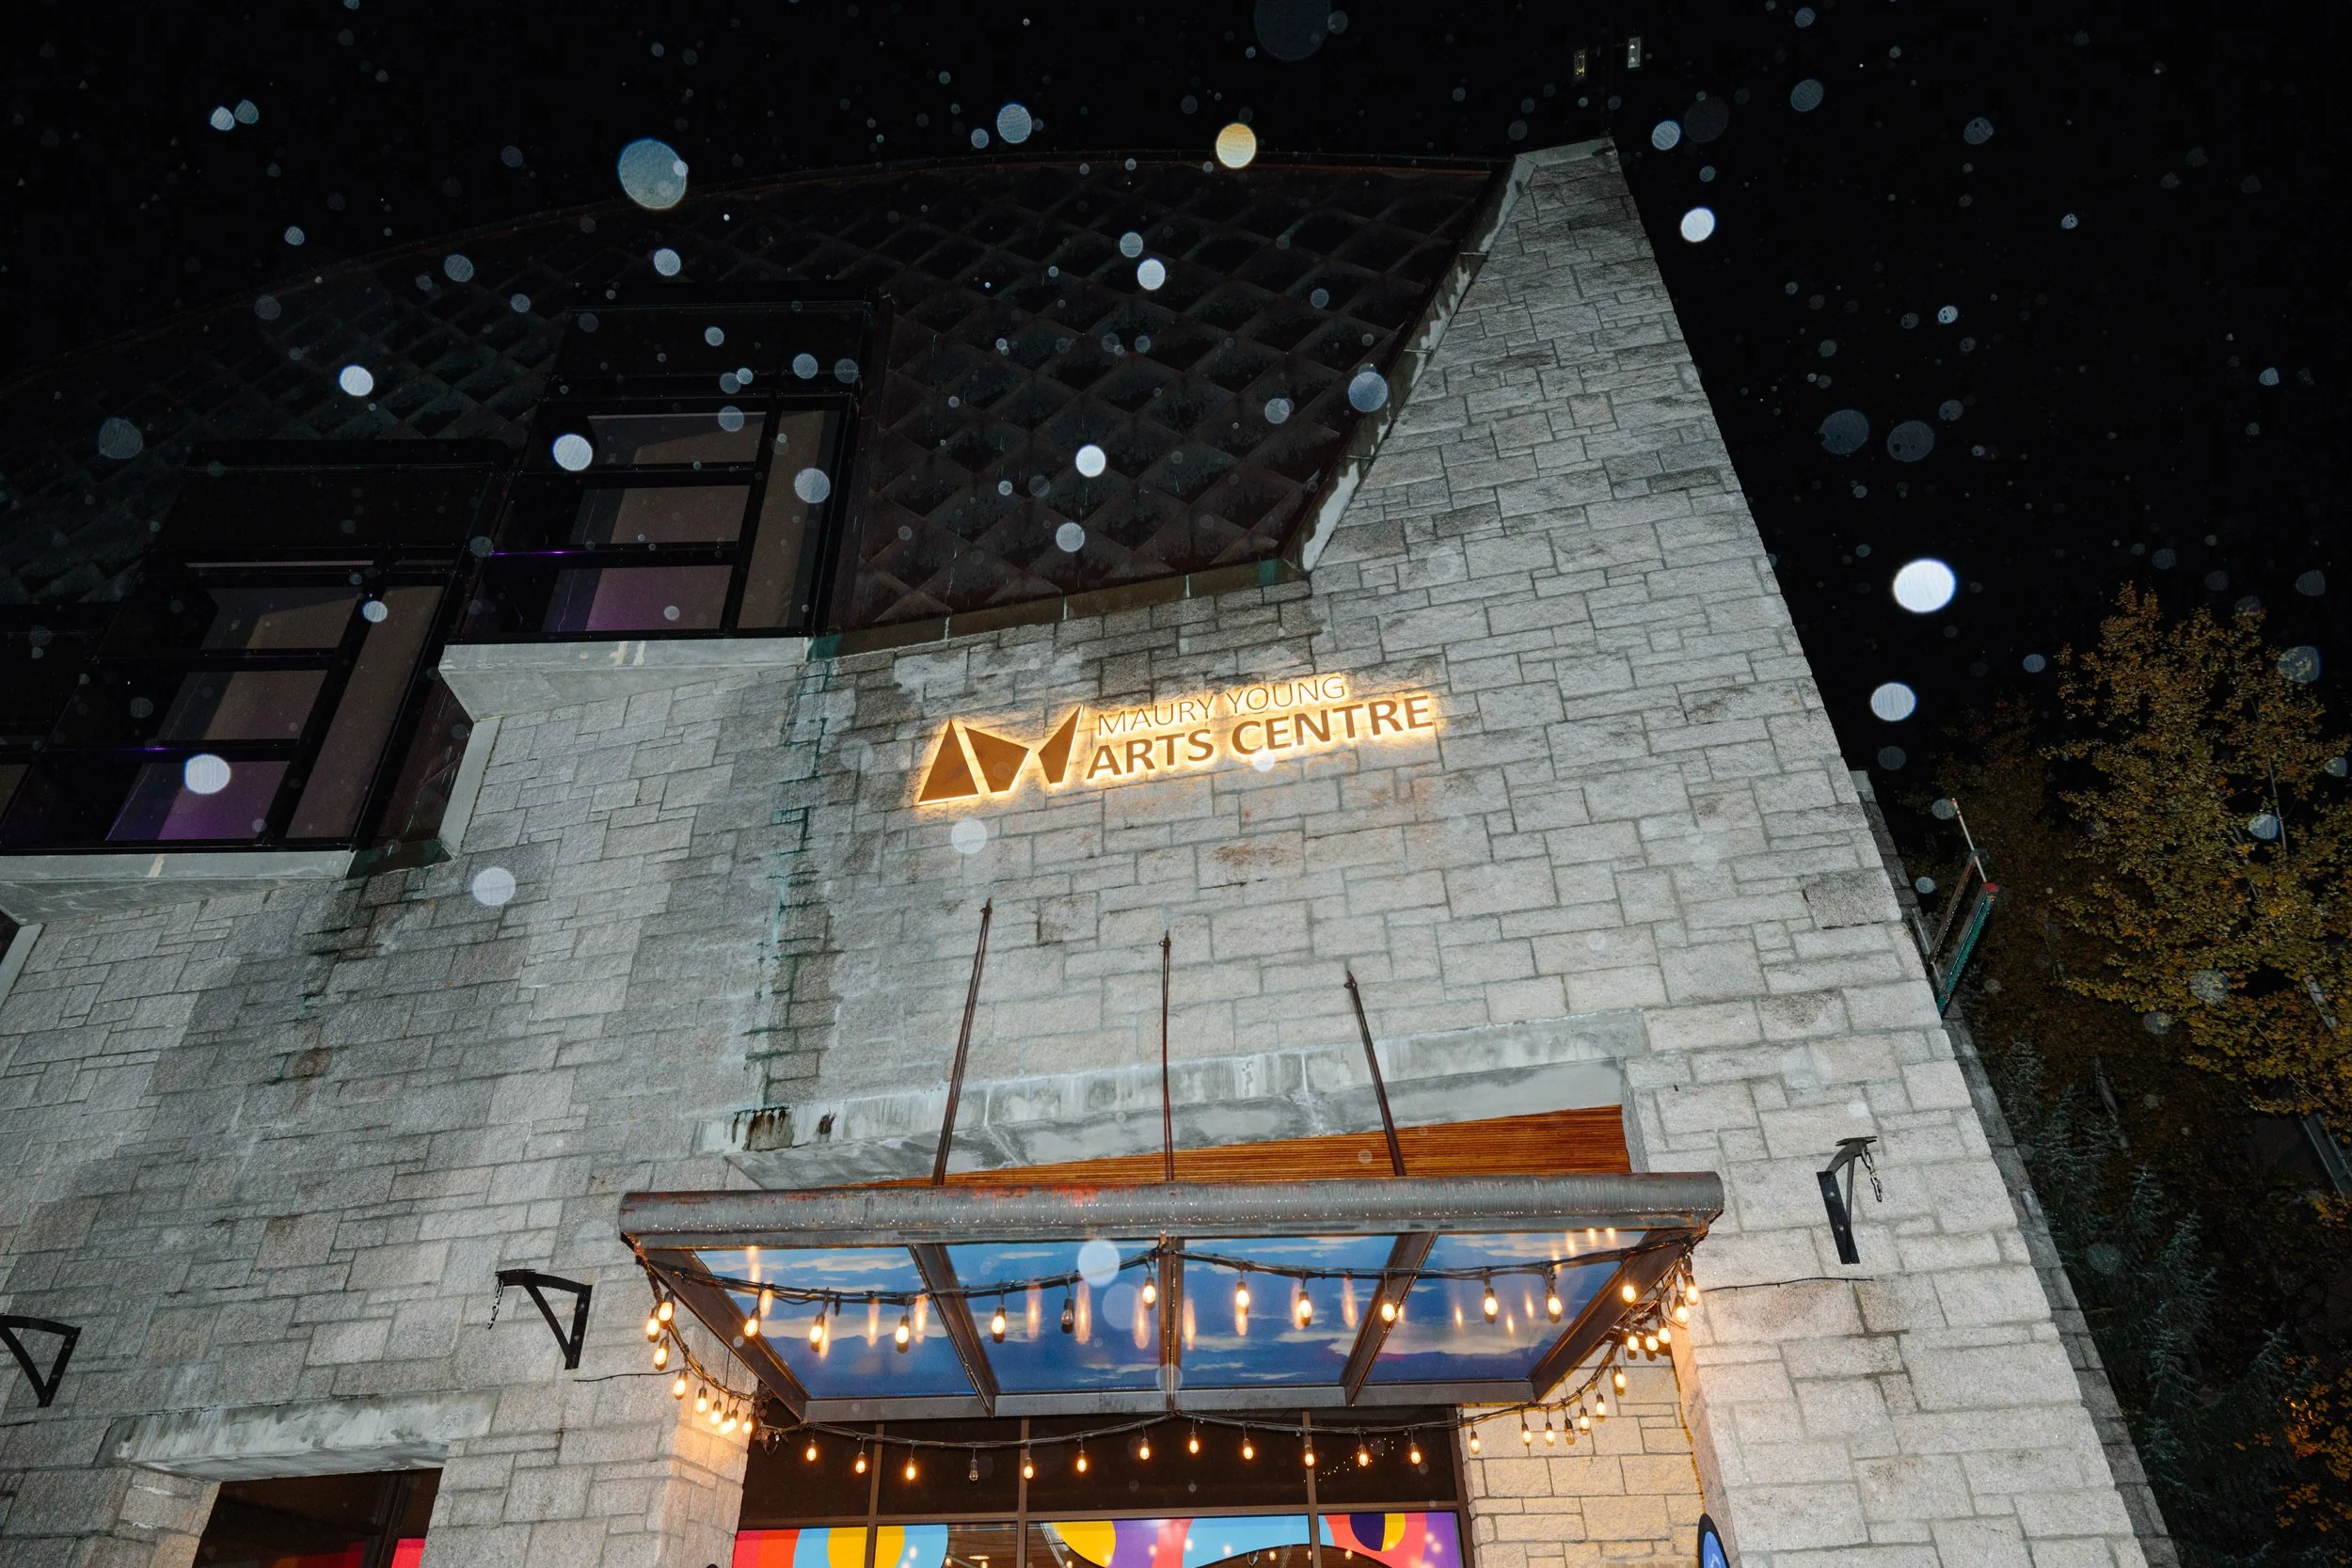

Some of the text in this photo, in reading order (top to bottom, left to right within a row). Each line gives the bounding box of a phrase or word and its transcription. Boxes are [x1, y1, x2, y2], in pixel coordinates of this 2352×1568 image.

[1086, 695, 1434, 780] ARTS CENTRE
[1098, 675, 1345, 736] MAURY YOUNG
